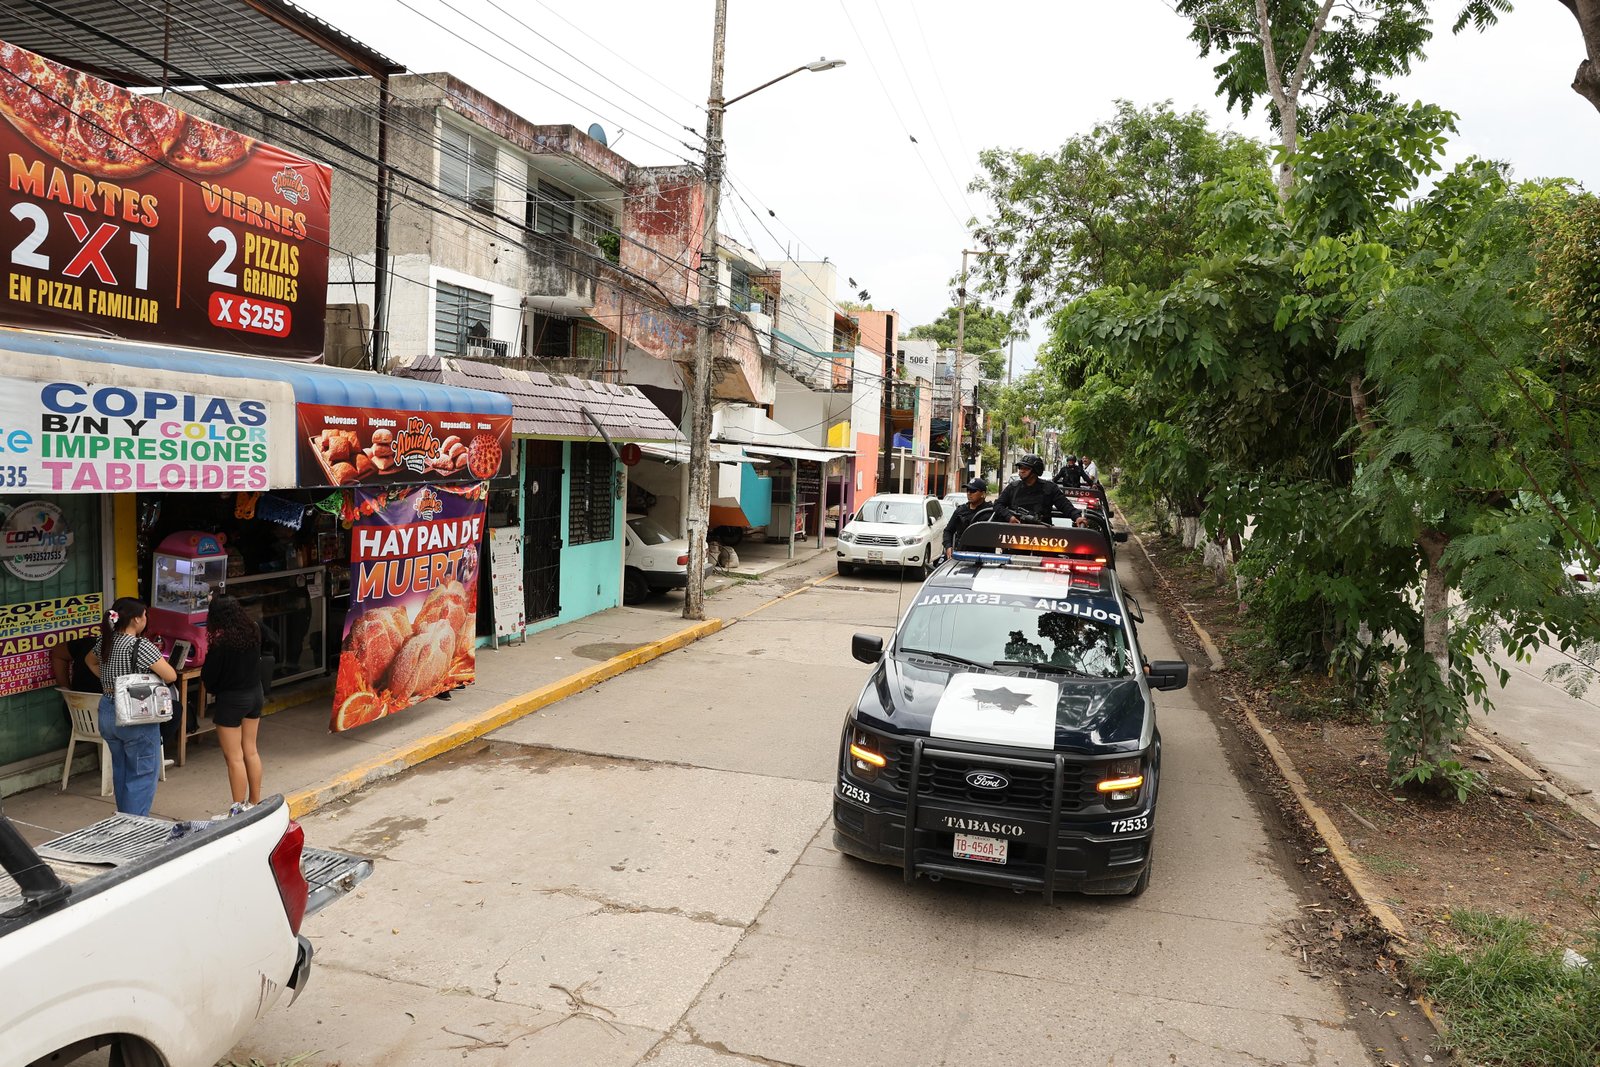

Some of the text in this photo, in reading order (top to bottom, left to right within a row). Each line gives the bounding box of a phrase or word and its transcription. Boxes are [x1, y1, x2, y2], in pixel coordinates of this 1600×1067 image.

[8, 153, 159, 228] MARTES
[201, 181, 307, 241] VIERNES
[207, 226, 238, 288] 2
[244, 231, 300, 277] PIZZAS
[9, 273, 159, 325] EN PIZZA FAMILIAR
[243, 267, 299, 303] GRANDES
[217, 297, 286, 333] X $255
[40, 382, 268, 427] COPIAS
[41, 413, 267, 443] B/N Y COLOR
[324, 415, 358, 426] Volovanes
[41, 434, 268, 464] IMPRESIONES
[396, 425, 440, 464] Abuelos
[41, 461, 268, 491] TABLOIDES
[359, 517, 481, 558] HAY PAN DE
[998, 534, 1069, 548] TABASCO
[0, 614, 101, 638] MPRESIONES
[43, 604, 100, 618] COLOR
[51, 613, 76, 621] DOBLE
[0, 625, 101, 657] ABLOIDES
[841, 782, 870, 804] 72533
[973, 774, 1000, 788] Ford
[944, 816, 1023, 837] TABASCO
[1111, 817, 1148, 833] 72533
[956, 838, 1006, 857] TB-456A-2
